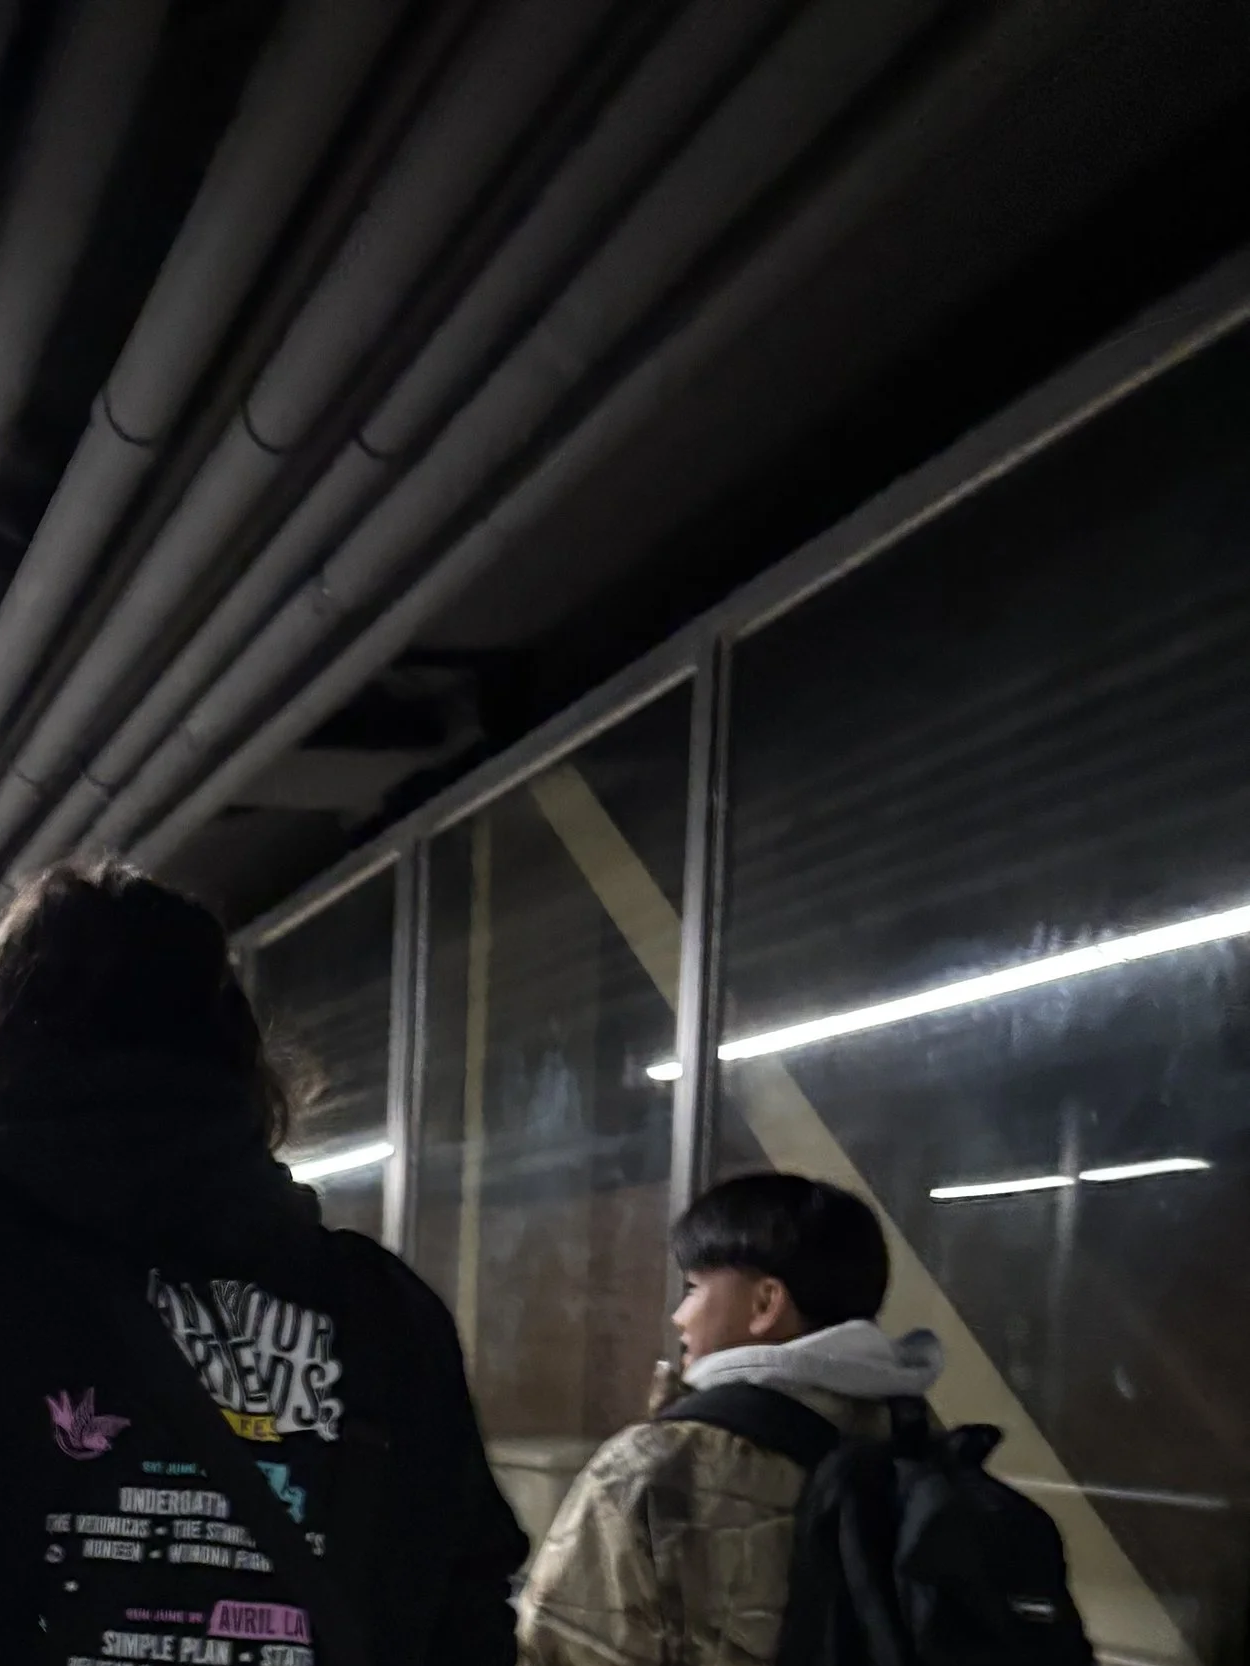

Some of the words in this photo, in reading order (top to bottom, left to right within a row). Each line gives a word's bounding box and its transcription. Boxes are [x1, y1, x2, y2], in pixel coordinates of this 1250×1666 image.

[119, 1486, 231, 1520] UNDEROATH
[219, 1603, 274, 1635] AVRIL
[102, 1631, 176, 1662] SIMPLE
[179, 1637, 233, 1666] PLAN
